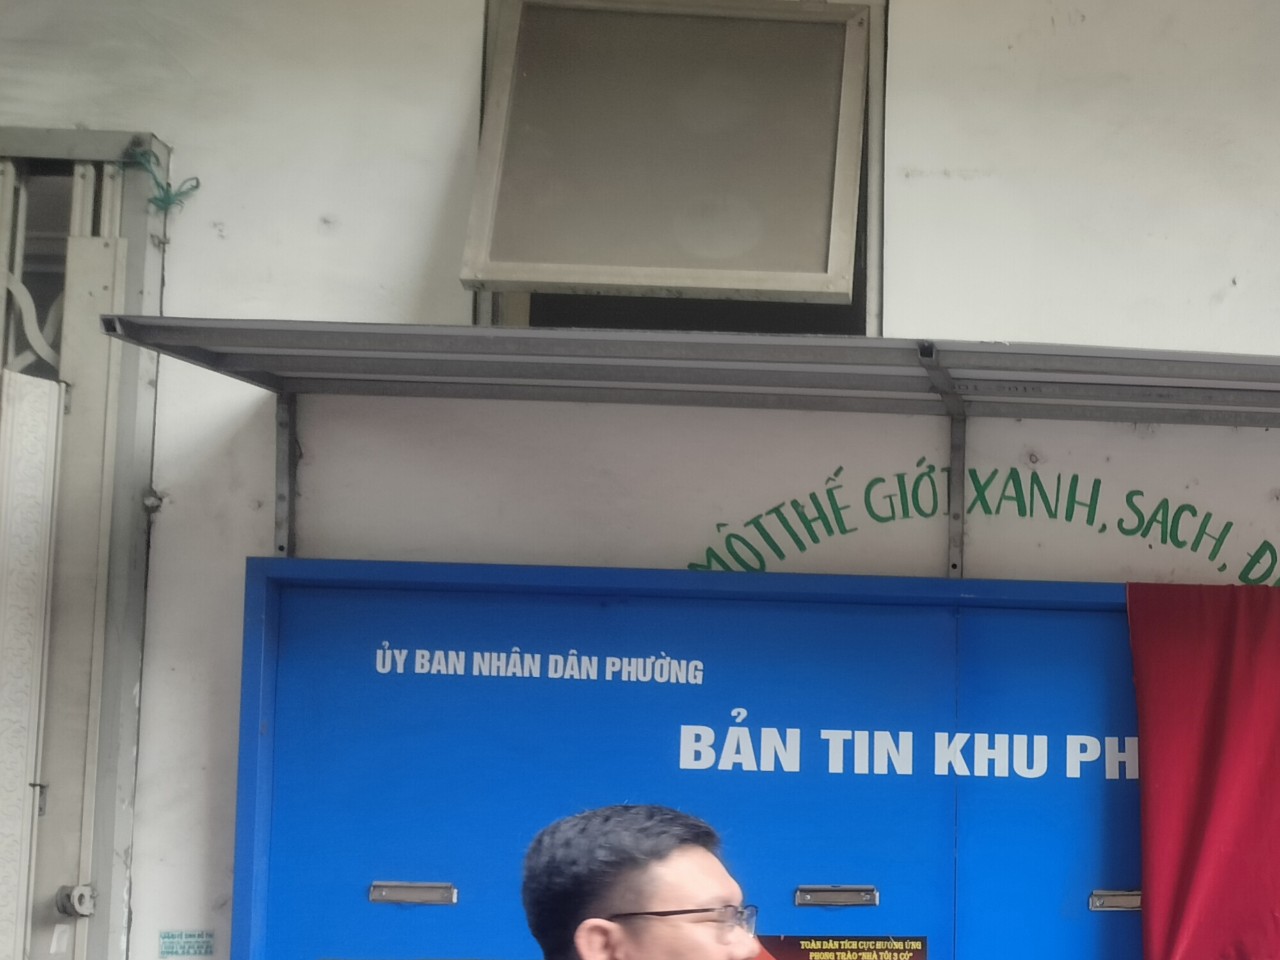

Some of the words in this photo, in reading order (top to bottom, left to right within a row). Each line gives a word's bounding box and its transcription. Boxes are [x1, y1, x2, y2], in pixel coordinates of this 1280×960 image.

[766, 466, 858, 554] THẾ
[966, 467, 1107, 533] XANH,
[375, 640, 407, 674] ỦY
[414, 649, 466, 675] BAN
[472, 646, 541, 678] NHÂN
[547, 648, 598, 680] DÂN
[605, 651, 704, 685] PHƯỜNG
[679, 707, 801, 773] BẢN
[820, 729, 914, 775] TIN
[934, 731, 1048, 779] KHU
[1066, 734, 1139, 781] PH
[809, 951, 836, 960] PHONG
[836, 951, 858, 960] TRÀO
